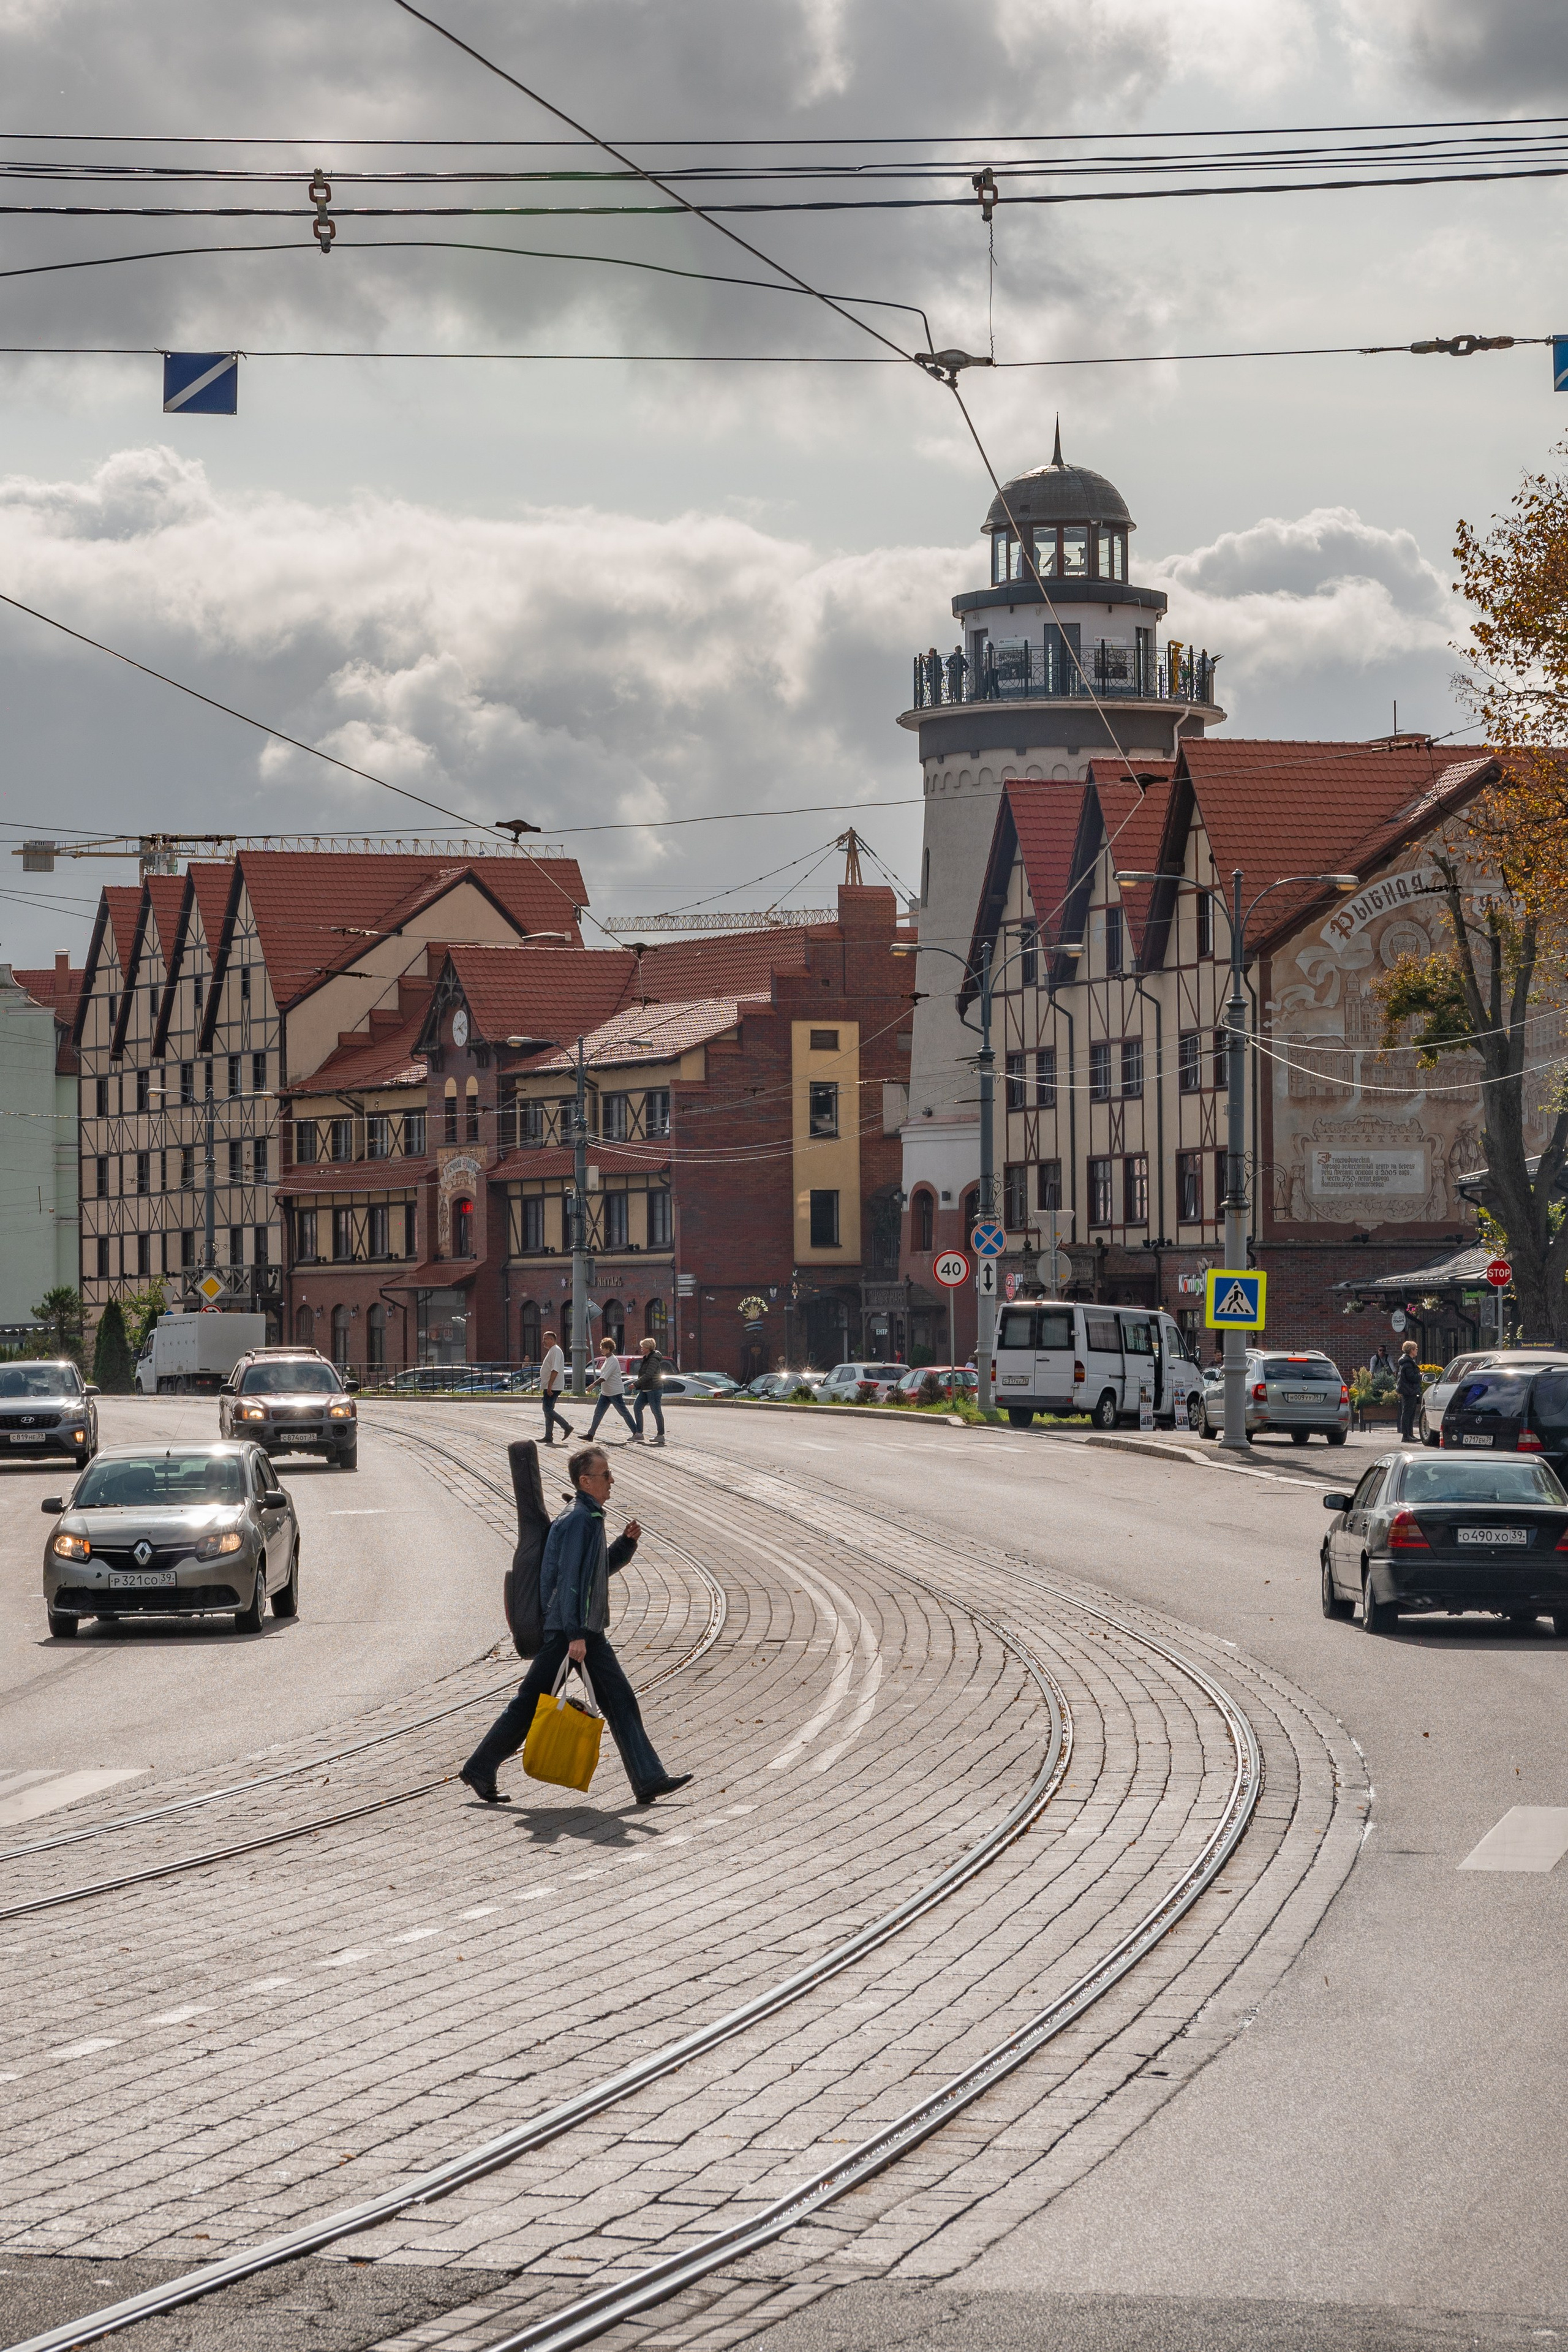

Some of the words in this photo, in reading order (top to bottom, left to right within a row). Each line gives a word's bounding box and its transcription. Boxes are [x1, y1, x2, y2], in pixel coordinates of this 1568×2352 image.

[941, 1262, 961, 1276] 40
[1488, 1268, 1510, 1278] STOP
[737, 1295, 769, 1312] ЭКСКУРСИИ
